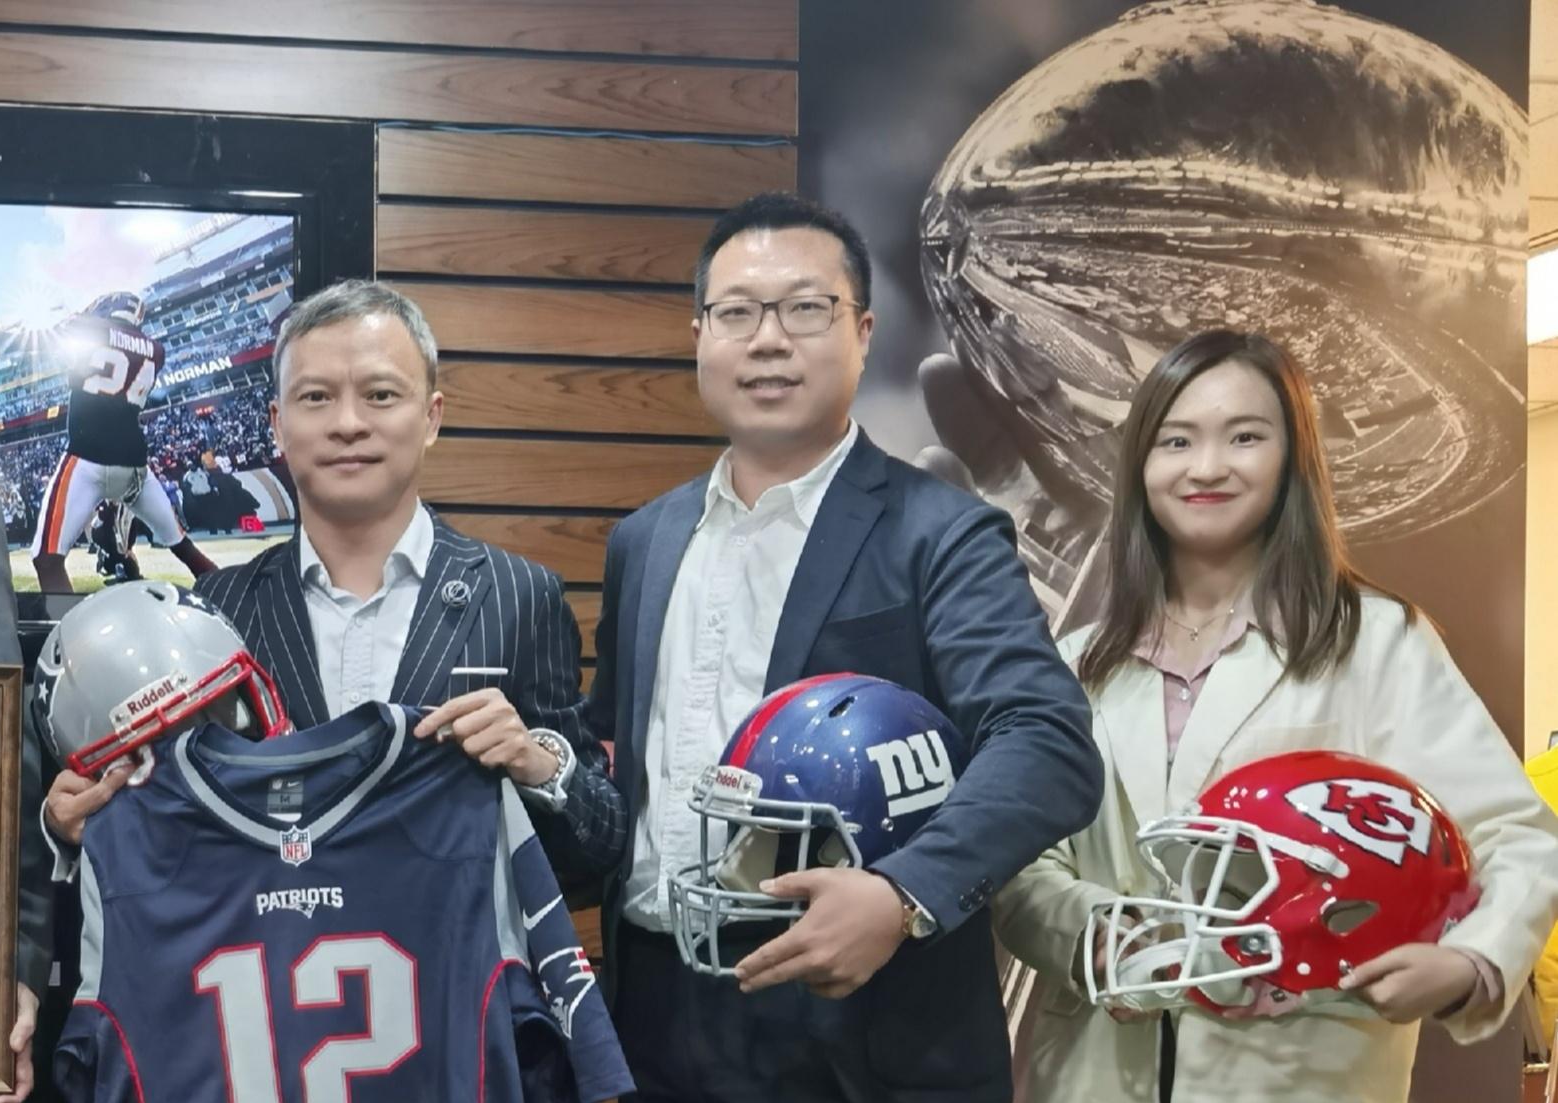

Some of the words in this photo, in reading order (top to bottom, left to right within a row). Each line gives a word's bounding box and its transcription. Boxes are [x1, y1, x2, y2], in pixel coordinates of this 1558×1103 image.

[109, 328, 155, 358] NORMAN
[162, 356, 234, 387] NORMAN
[127, 679, 175, 716] Riddell
[285, 843, 309, 859] NFL
[256, 887, 344, 916] PATRIOTS
